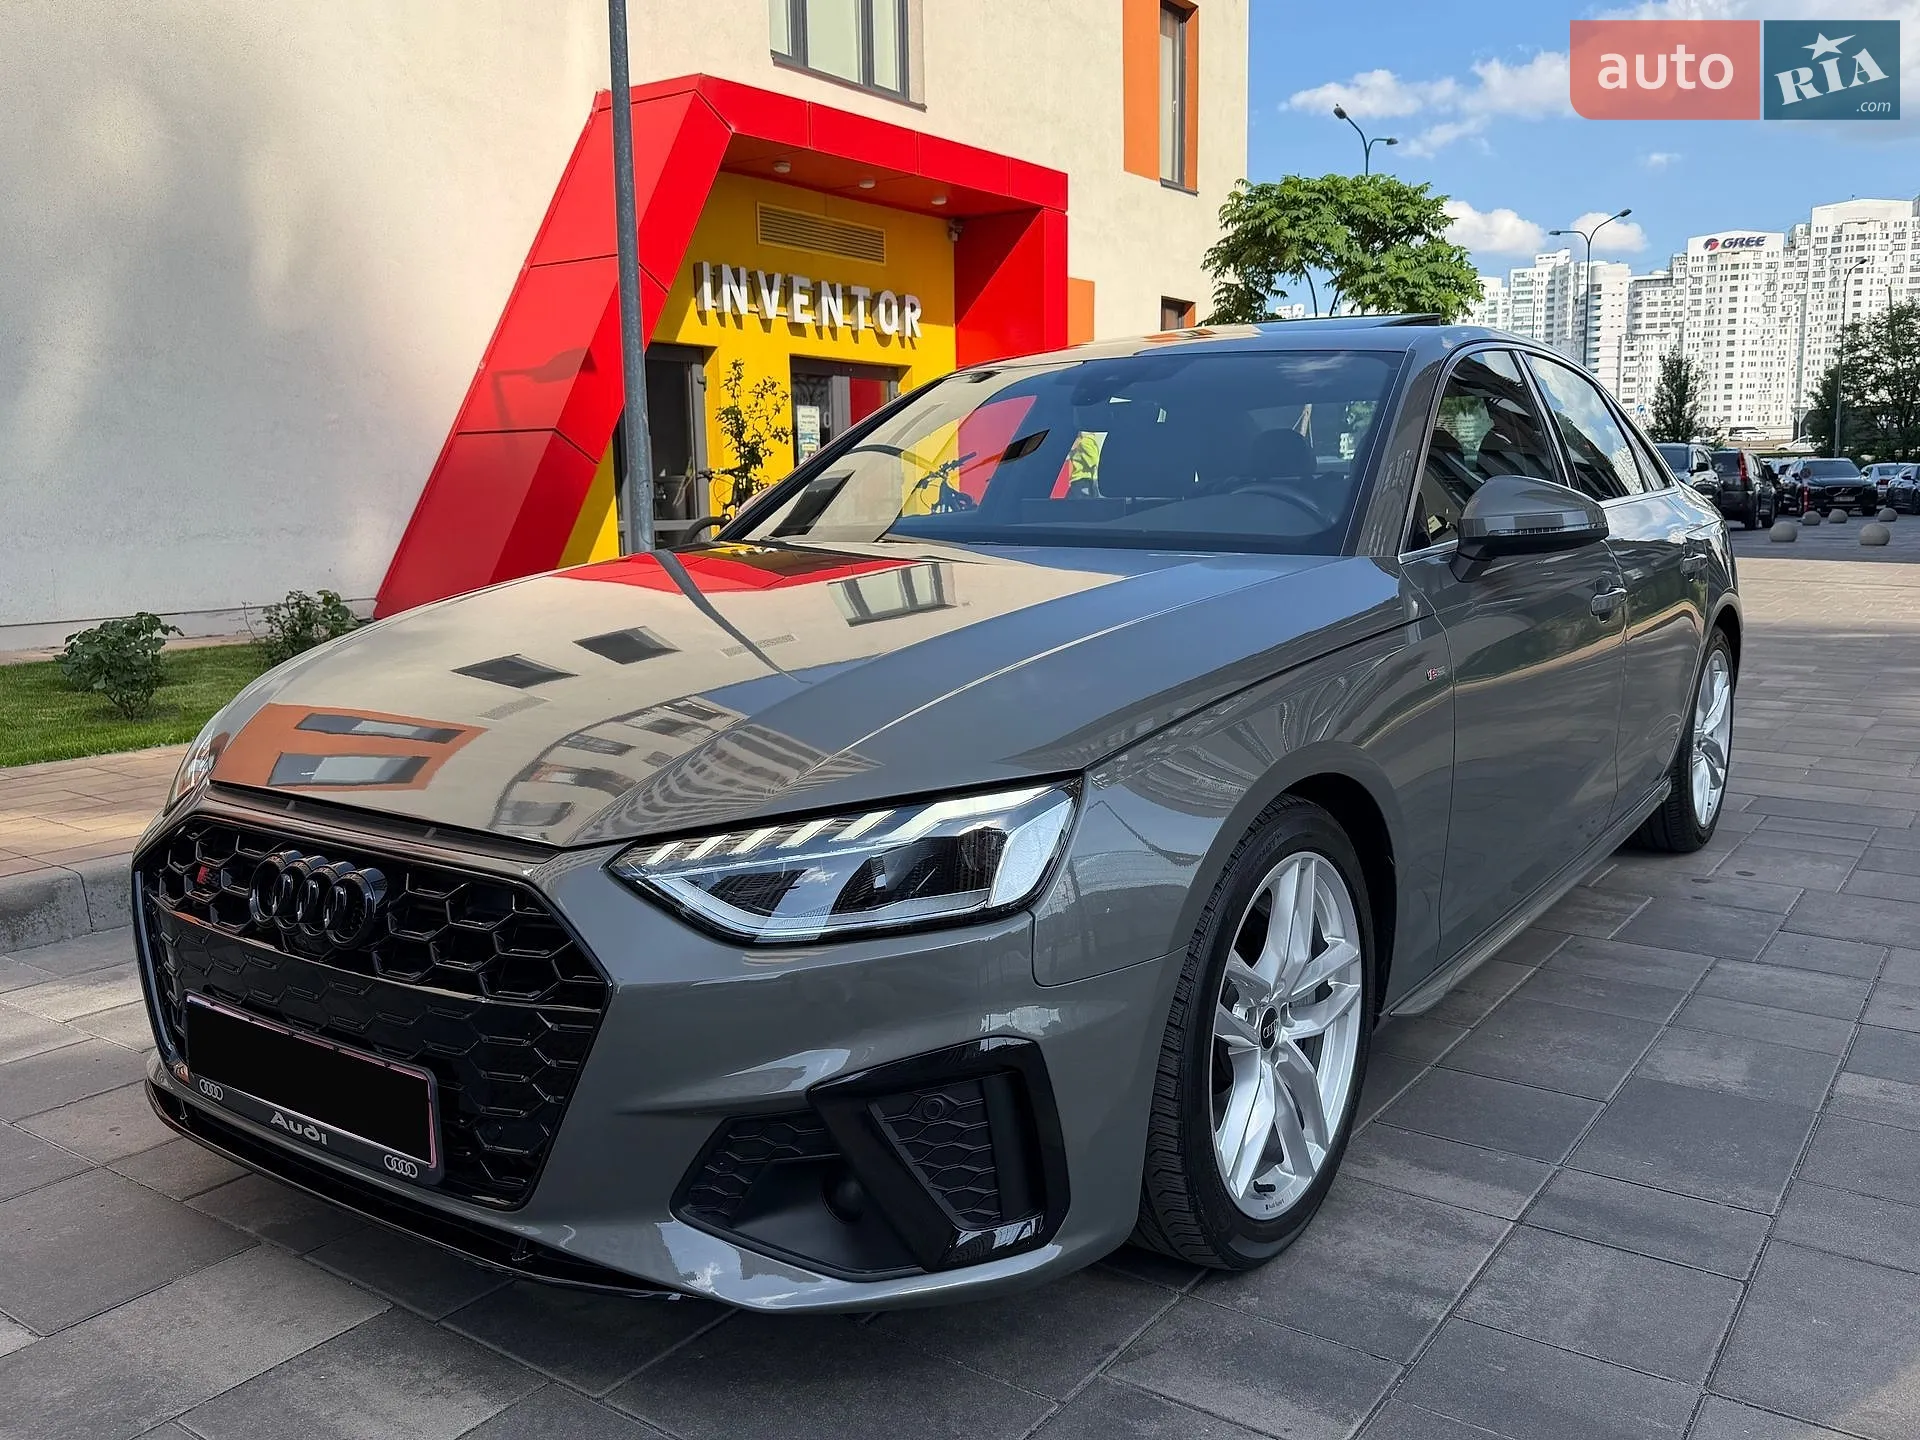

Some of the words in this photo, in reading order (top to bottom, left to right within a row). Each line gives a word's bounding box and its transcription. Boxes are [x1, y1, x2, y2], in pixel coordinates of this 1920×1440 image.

[1721, 236, 1767, 249] GREE
[694, 260, 922, 338] INVENTOR
[271, 1110, 328, 1145] Audi
